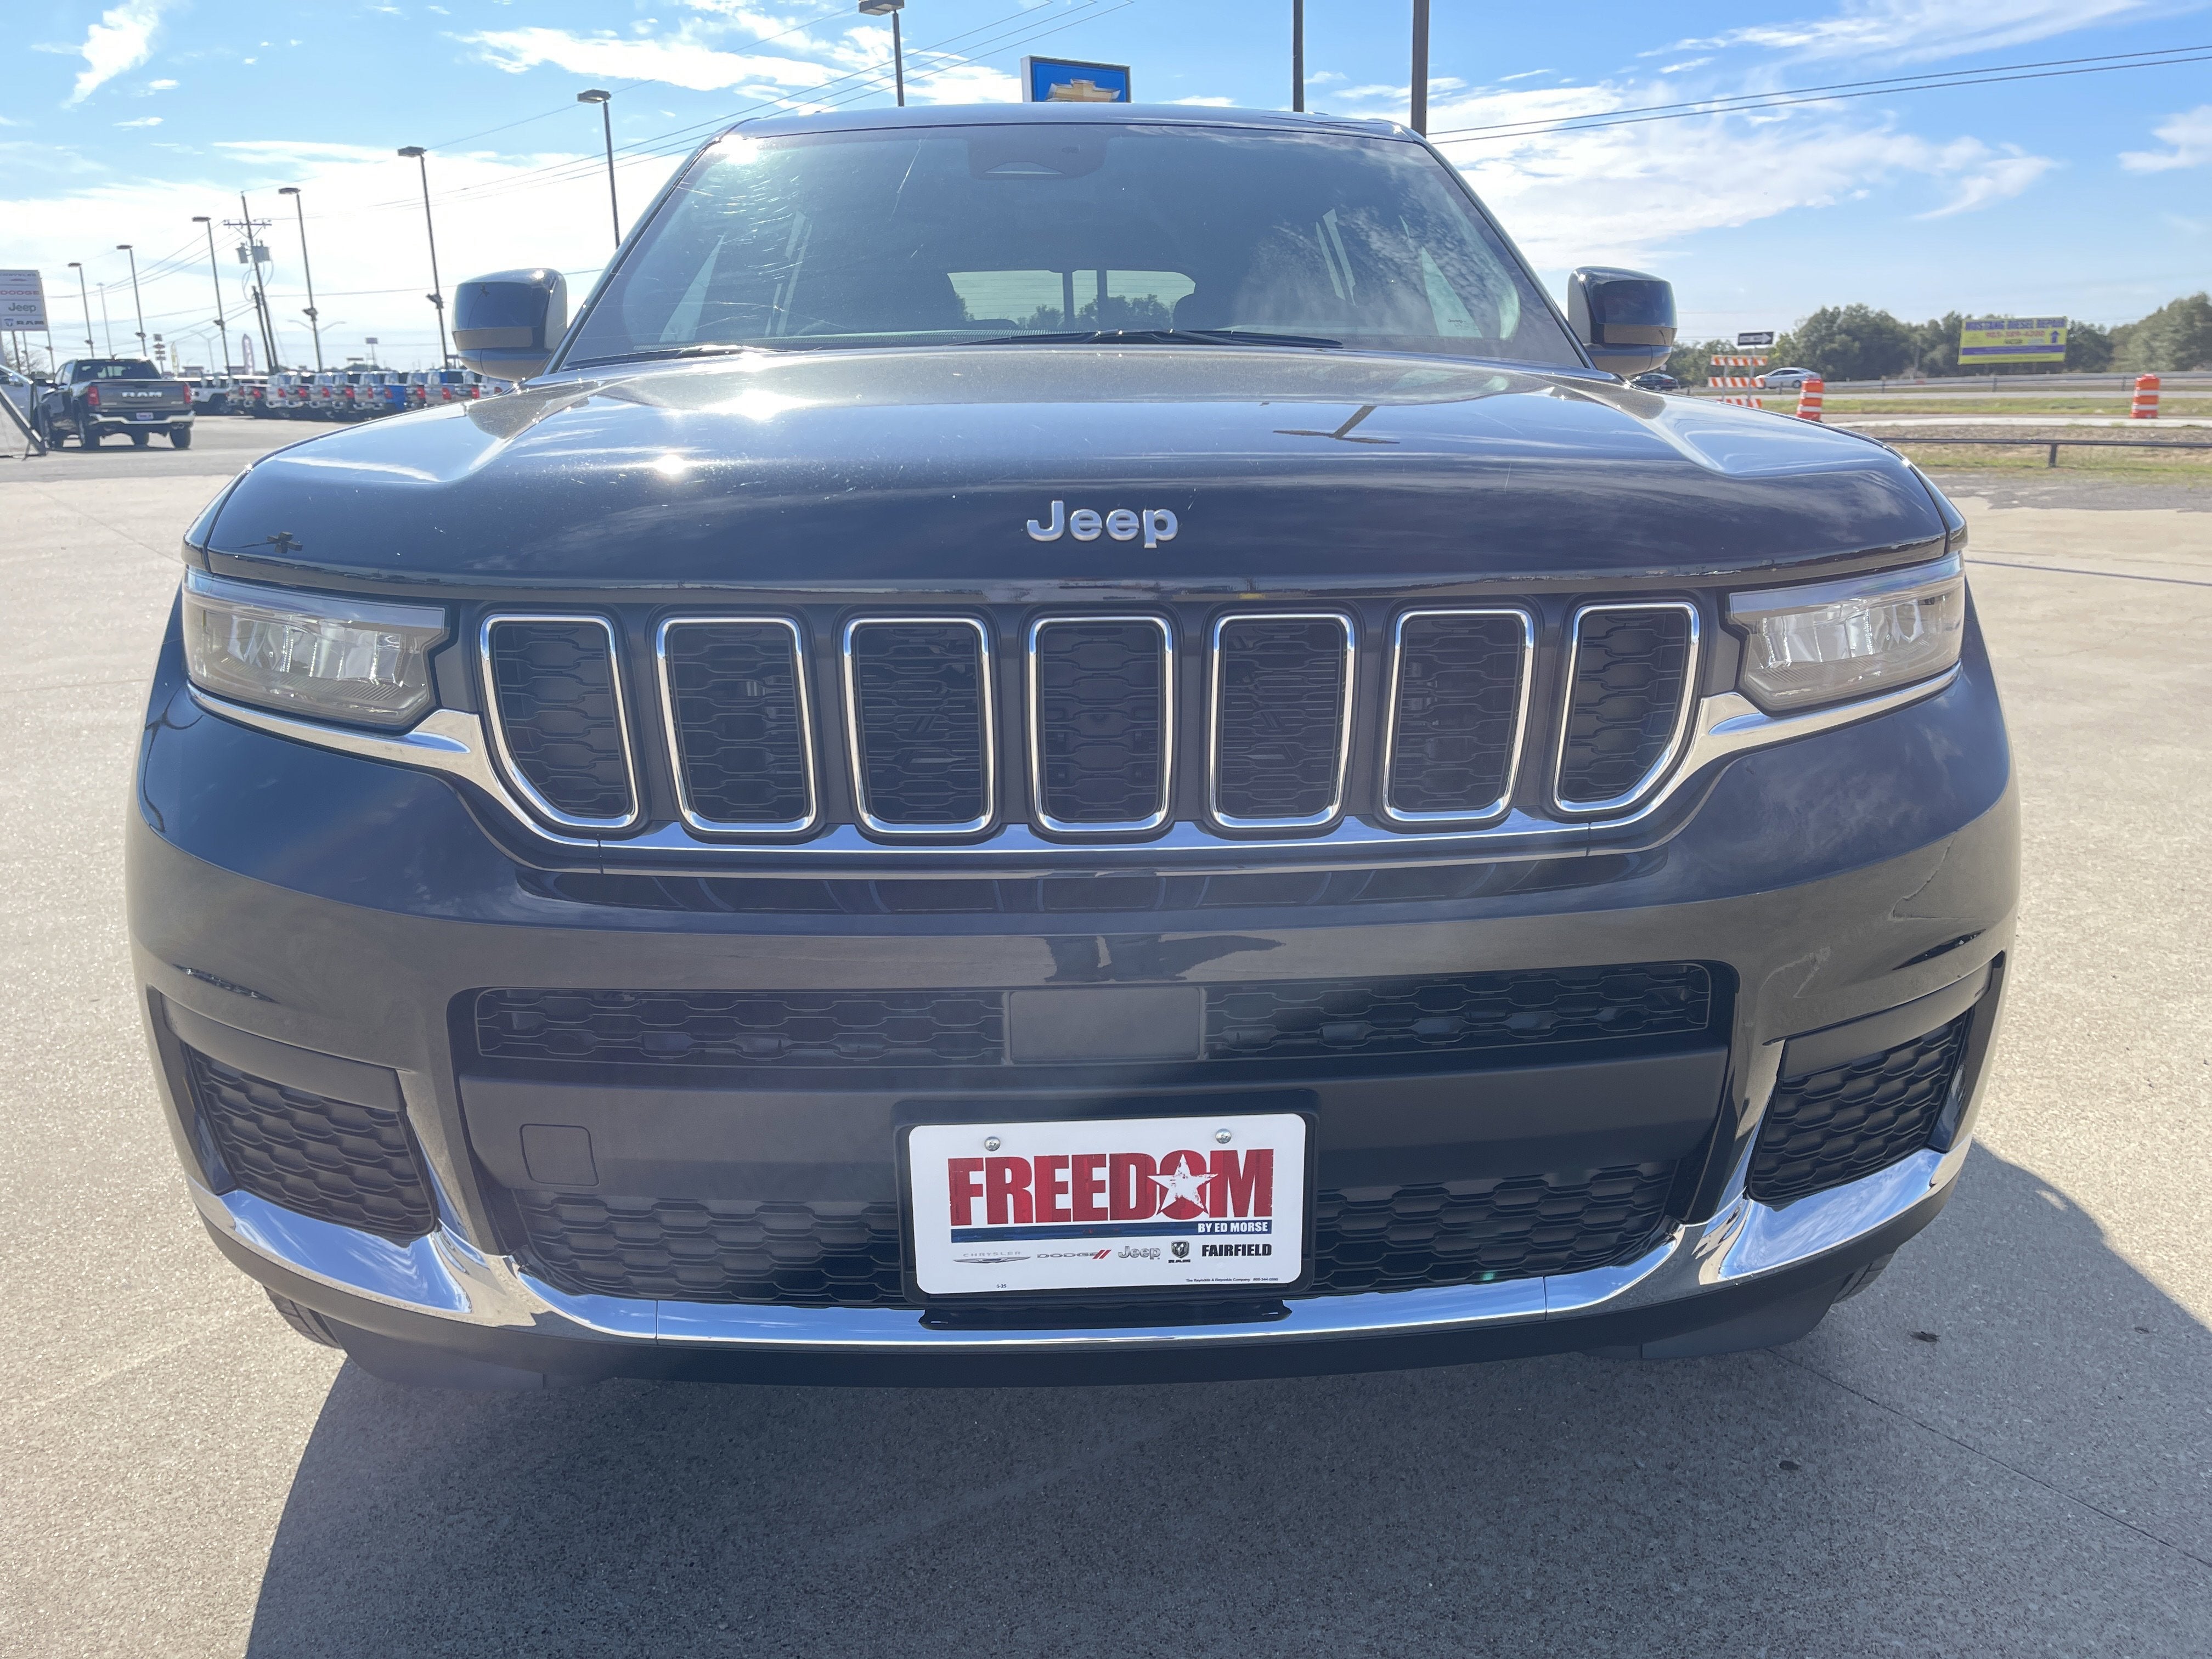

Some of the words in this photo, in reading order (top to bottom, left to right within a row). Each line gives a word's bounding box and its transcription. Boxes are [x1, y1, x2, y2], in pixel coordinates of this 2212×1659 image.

[8, 302, 37, 313] Jeep
[1026, 500, 1179, 549] Jeep
[947, 1148, 1274, 1226] FREEDOM
[1198, 1223, 1212, 1233] BY
[1214, 1222, 1228, 1233] ED
[1230, 1221, 1268, 1233] MORSE
[1118, 1246, 1161, 1260] Jeep
[1201, 1244, 1272, 1257] FAIRFIELD
